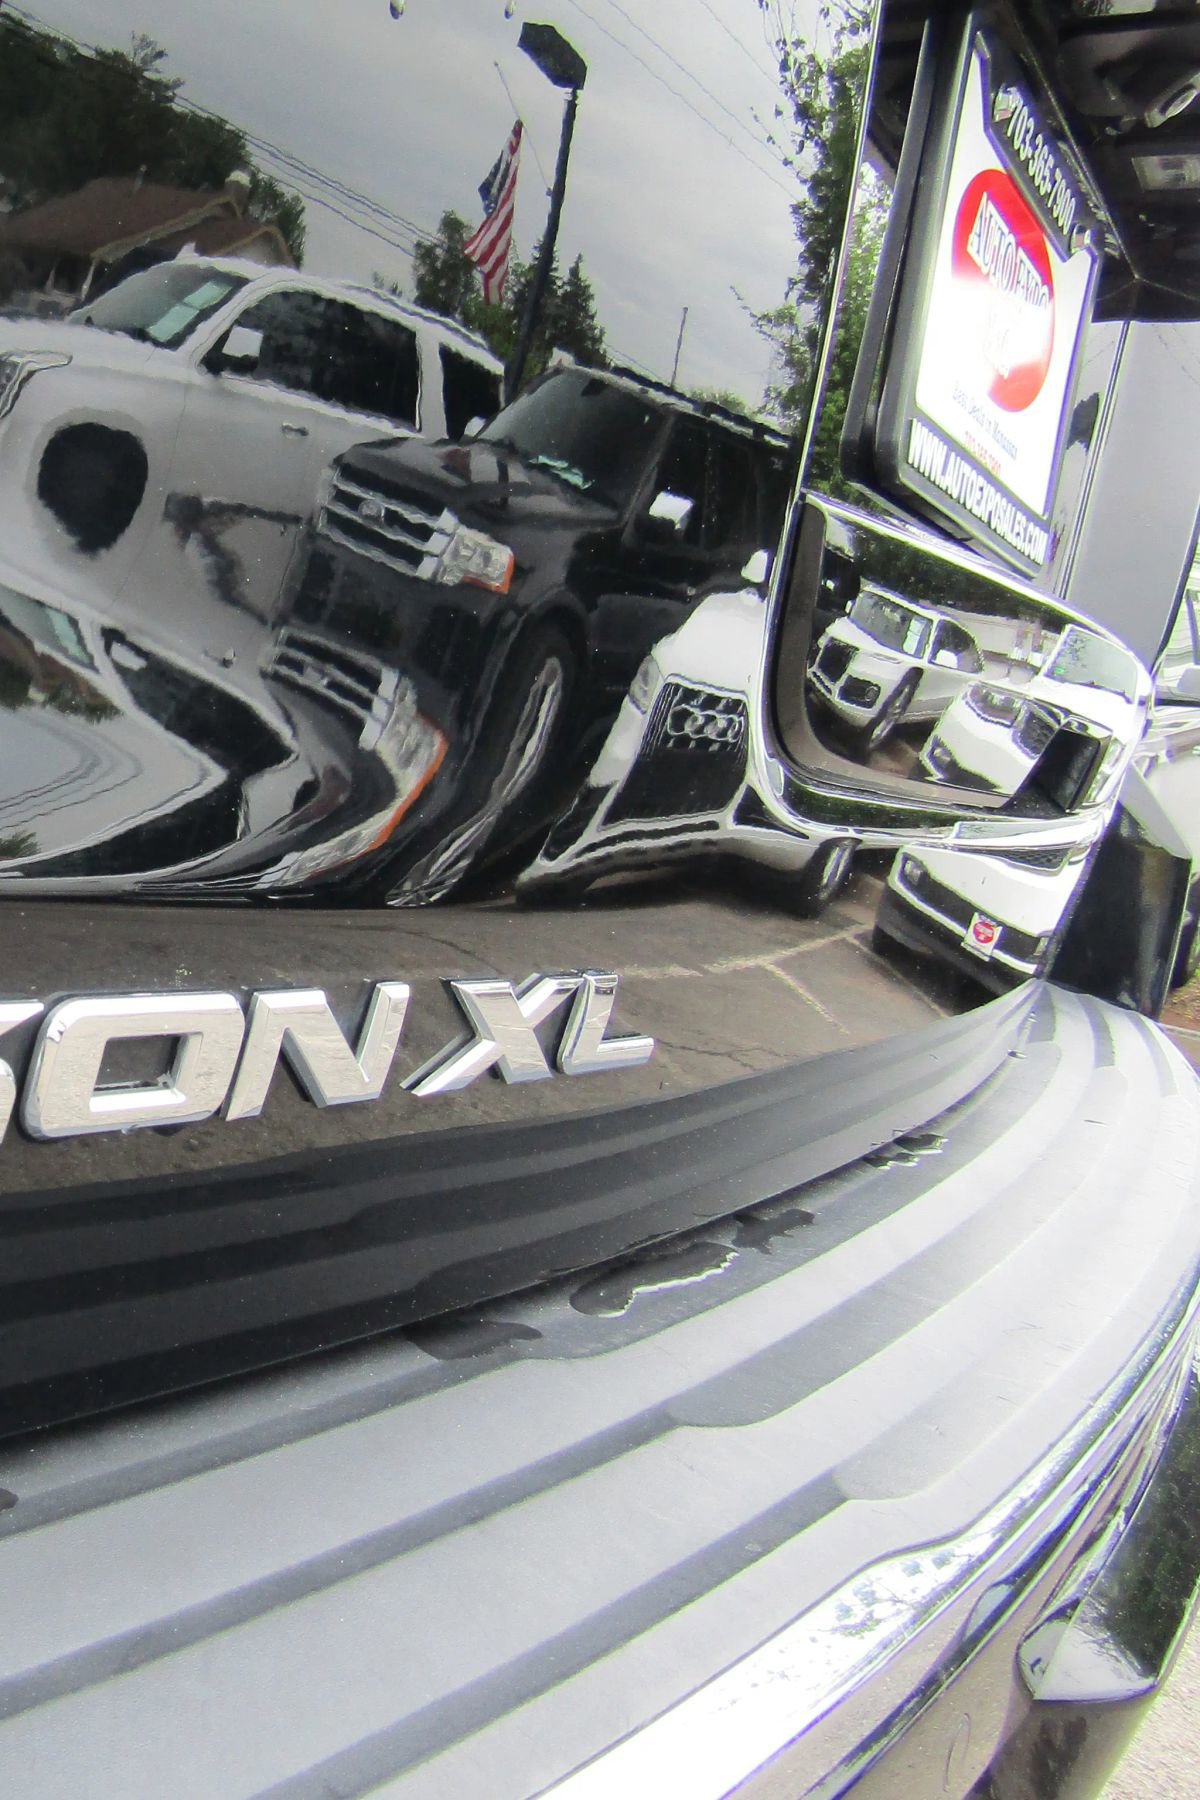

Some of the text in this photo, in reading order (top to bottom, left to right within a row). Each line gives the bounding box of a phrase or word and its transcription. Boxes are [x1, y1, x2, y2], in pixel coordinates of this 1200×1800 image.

[1007, 87, 1075, 235] 703-365-7900
[970, 208, 1014, 291] AUTO
[908, 418, 1048, 565] WWW.AUTOEXPOSALES.COM
[401, 972, 655, 1097] XL
